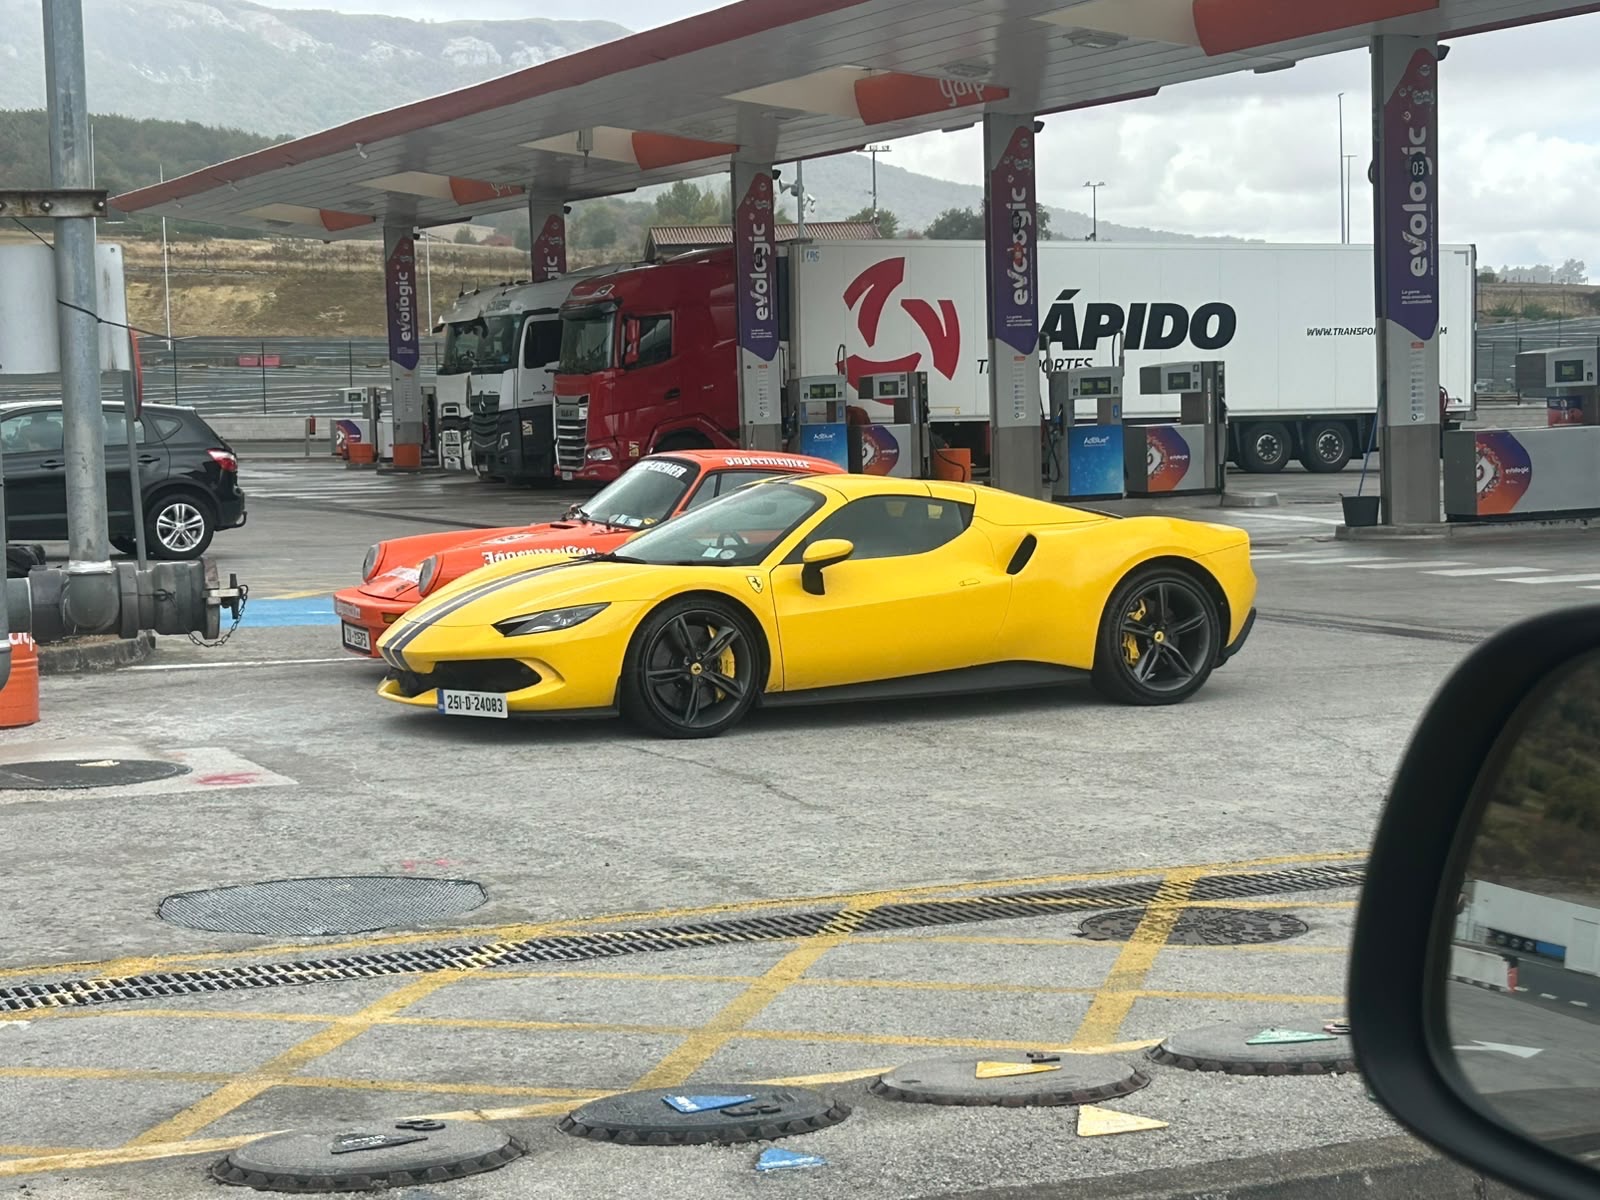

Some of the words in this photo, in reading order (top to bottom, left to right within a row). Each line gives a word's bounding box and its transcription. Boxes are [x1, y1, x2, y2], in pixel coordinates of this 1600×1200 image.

[1412, 161, 1424, 176] 03
[1401, 126, 1433, 277] evoloic
[395, 271, 413, 342] evologic
[1039, 289, 1237, 350] ÁPIDO
[447, 694, 503, 712] 251-D-24083
